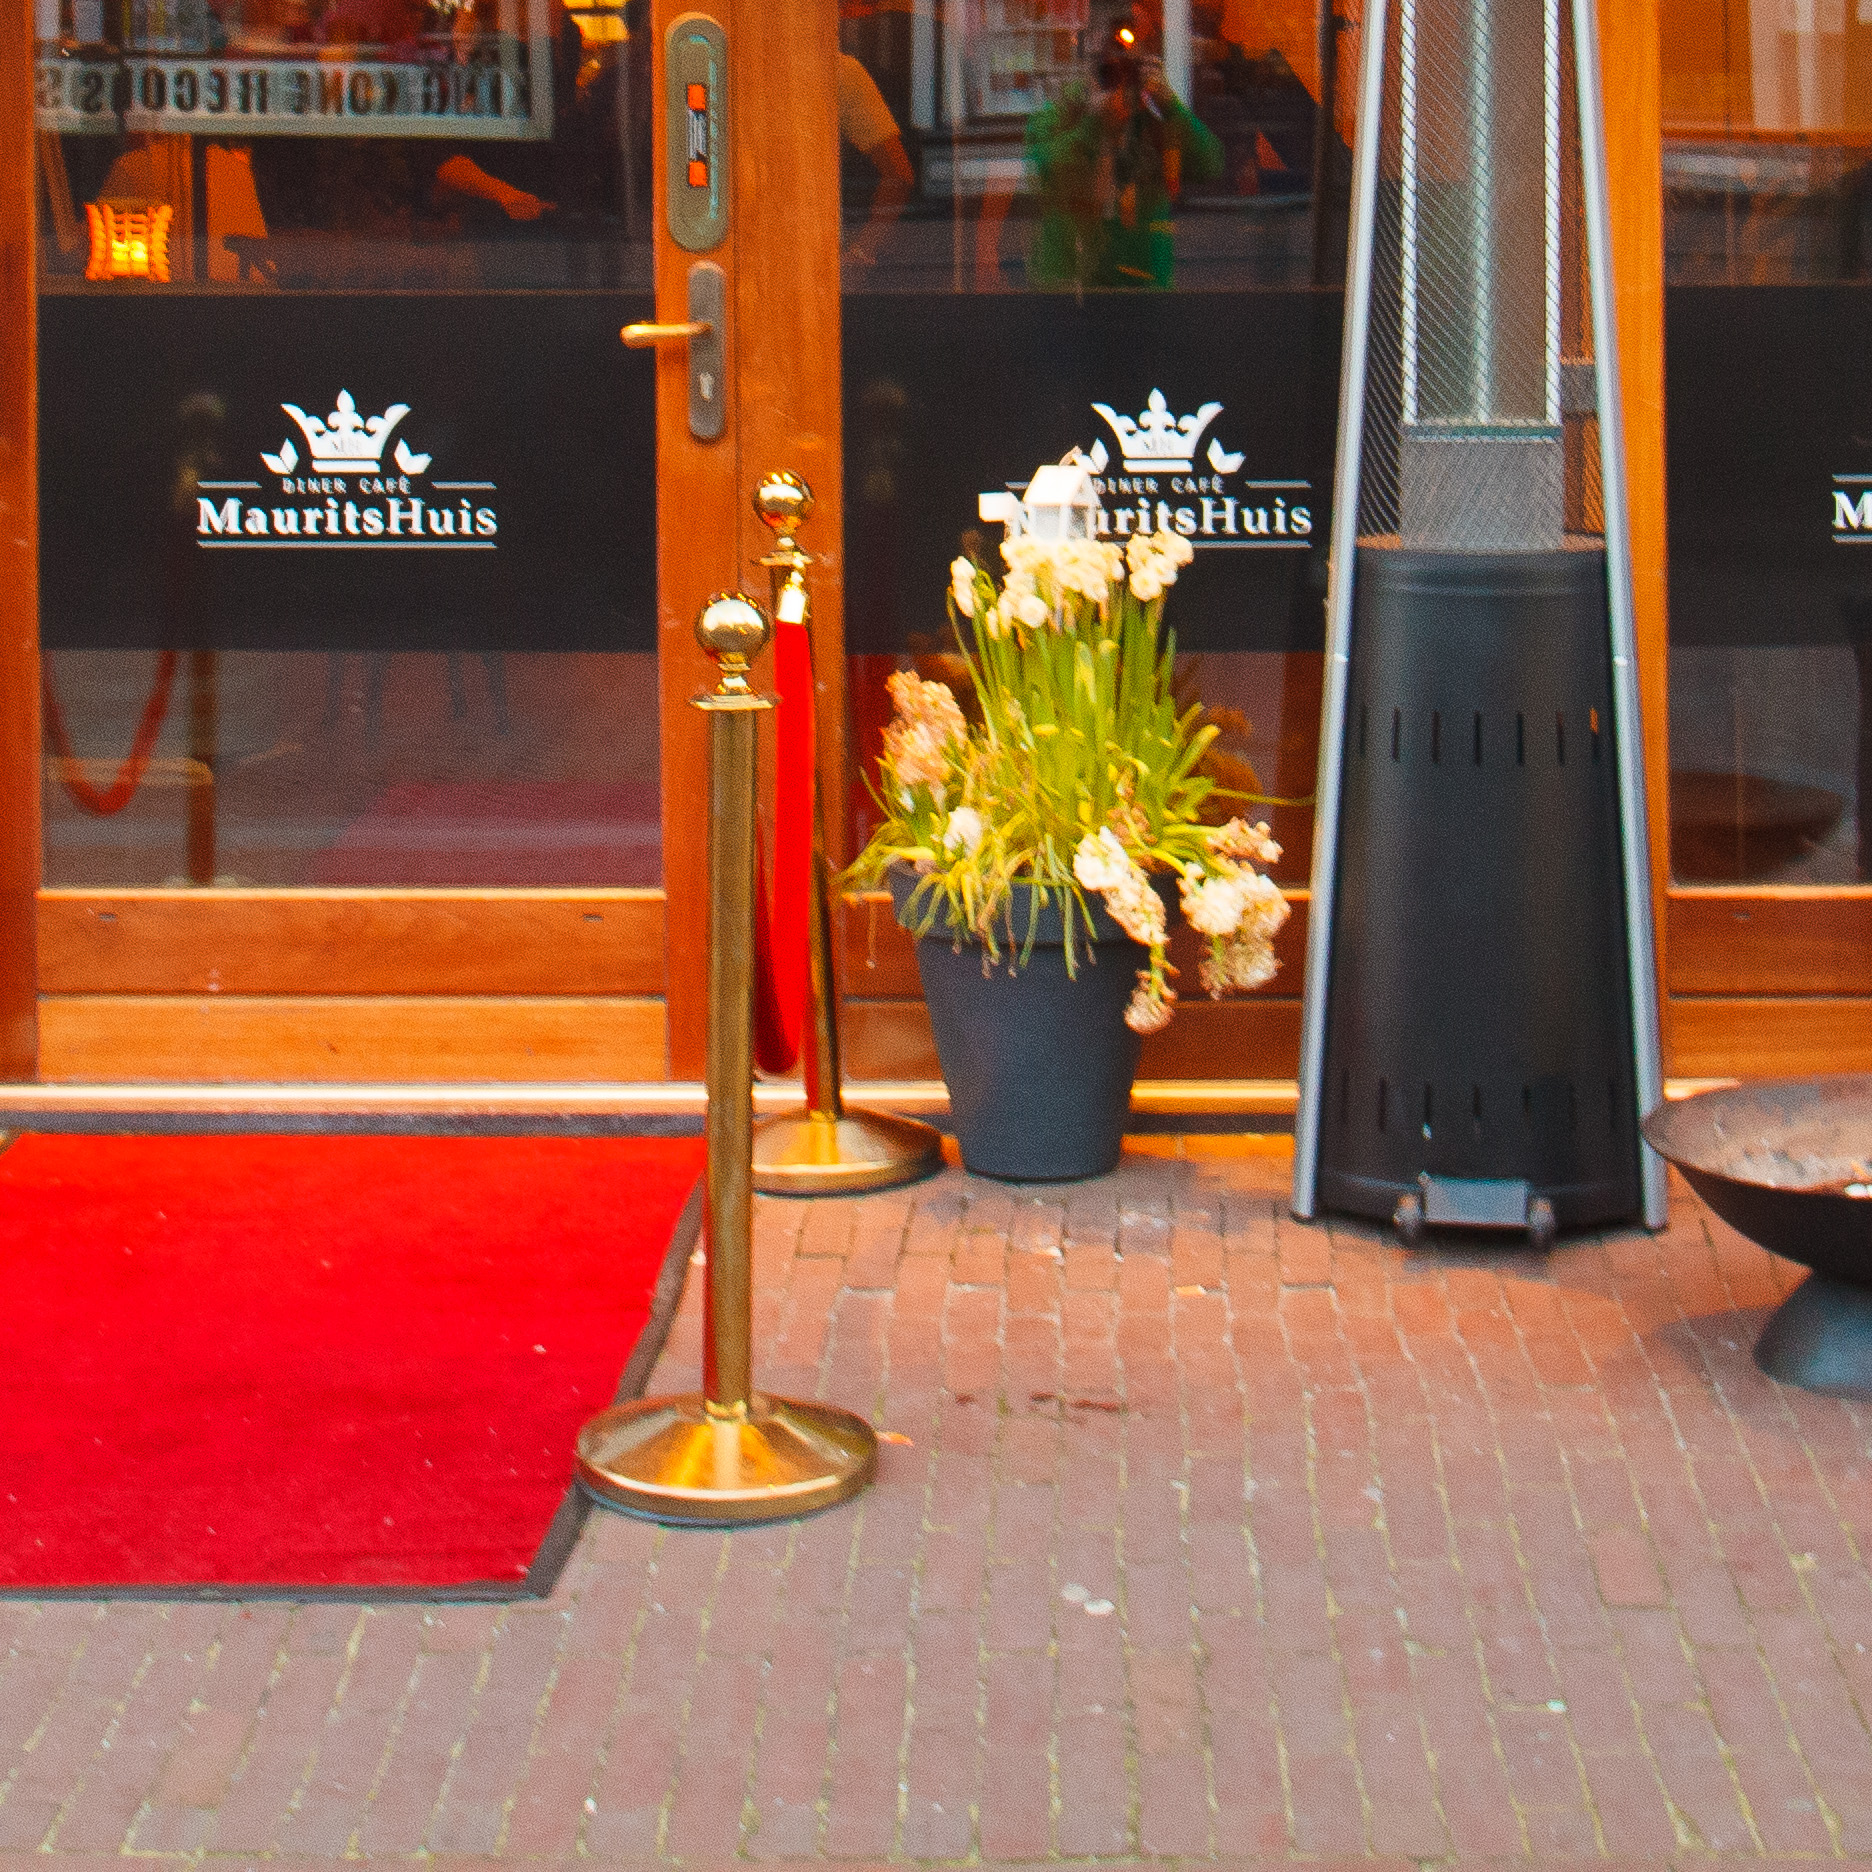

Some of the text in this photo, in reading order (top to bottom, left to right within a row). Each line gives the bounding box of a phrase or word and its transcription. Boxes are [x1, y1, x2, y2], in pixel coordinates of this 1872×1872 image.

[282, 477, 348, 495] DINER
[1092, 476, 1159, 495] DINER
[196, 496, 498, 536] MauritsHuis
